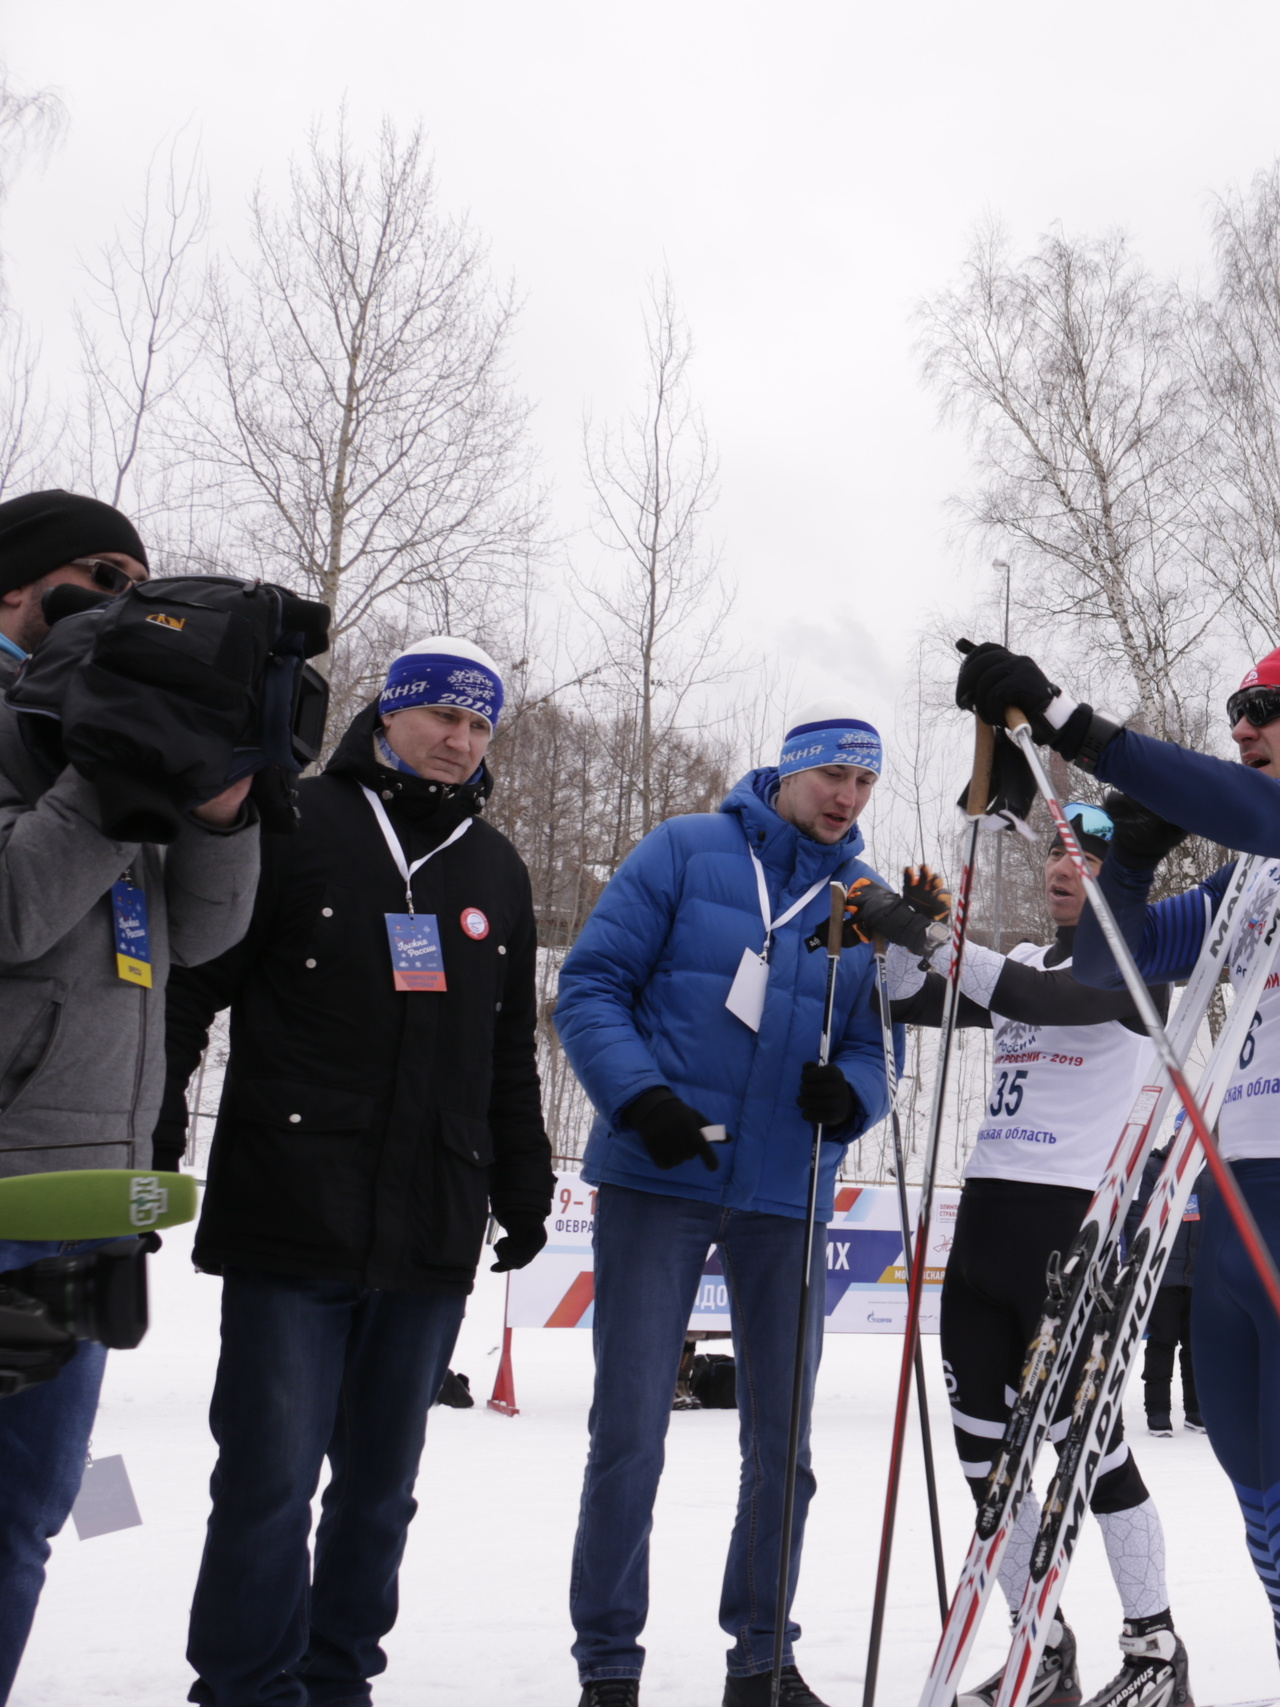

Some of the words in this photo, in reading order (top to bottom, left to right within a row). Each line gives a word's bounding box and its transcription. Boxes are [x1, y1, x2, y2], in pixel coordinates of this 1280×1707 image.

[438, 693, 493, 716] 2019
[832, 753, 880, 769] 2019
[1049, 1053, 1084, 1067] 2019
[989, 1069, 1029, 1117] 35
[1005, 1127, 1057, 1145] область
[1062, 1245, 1166, 1559] MADSHUS
[1107, 1666, 1154, 1707] MADSHUS
